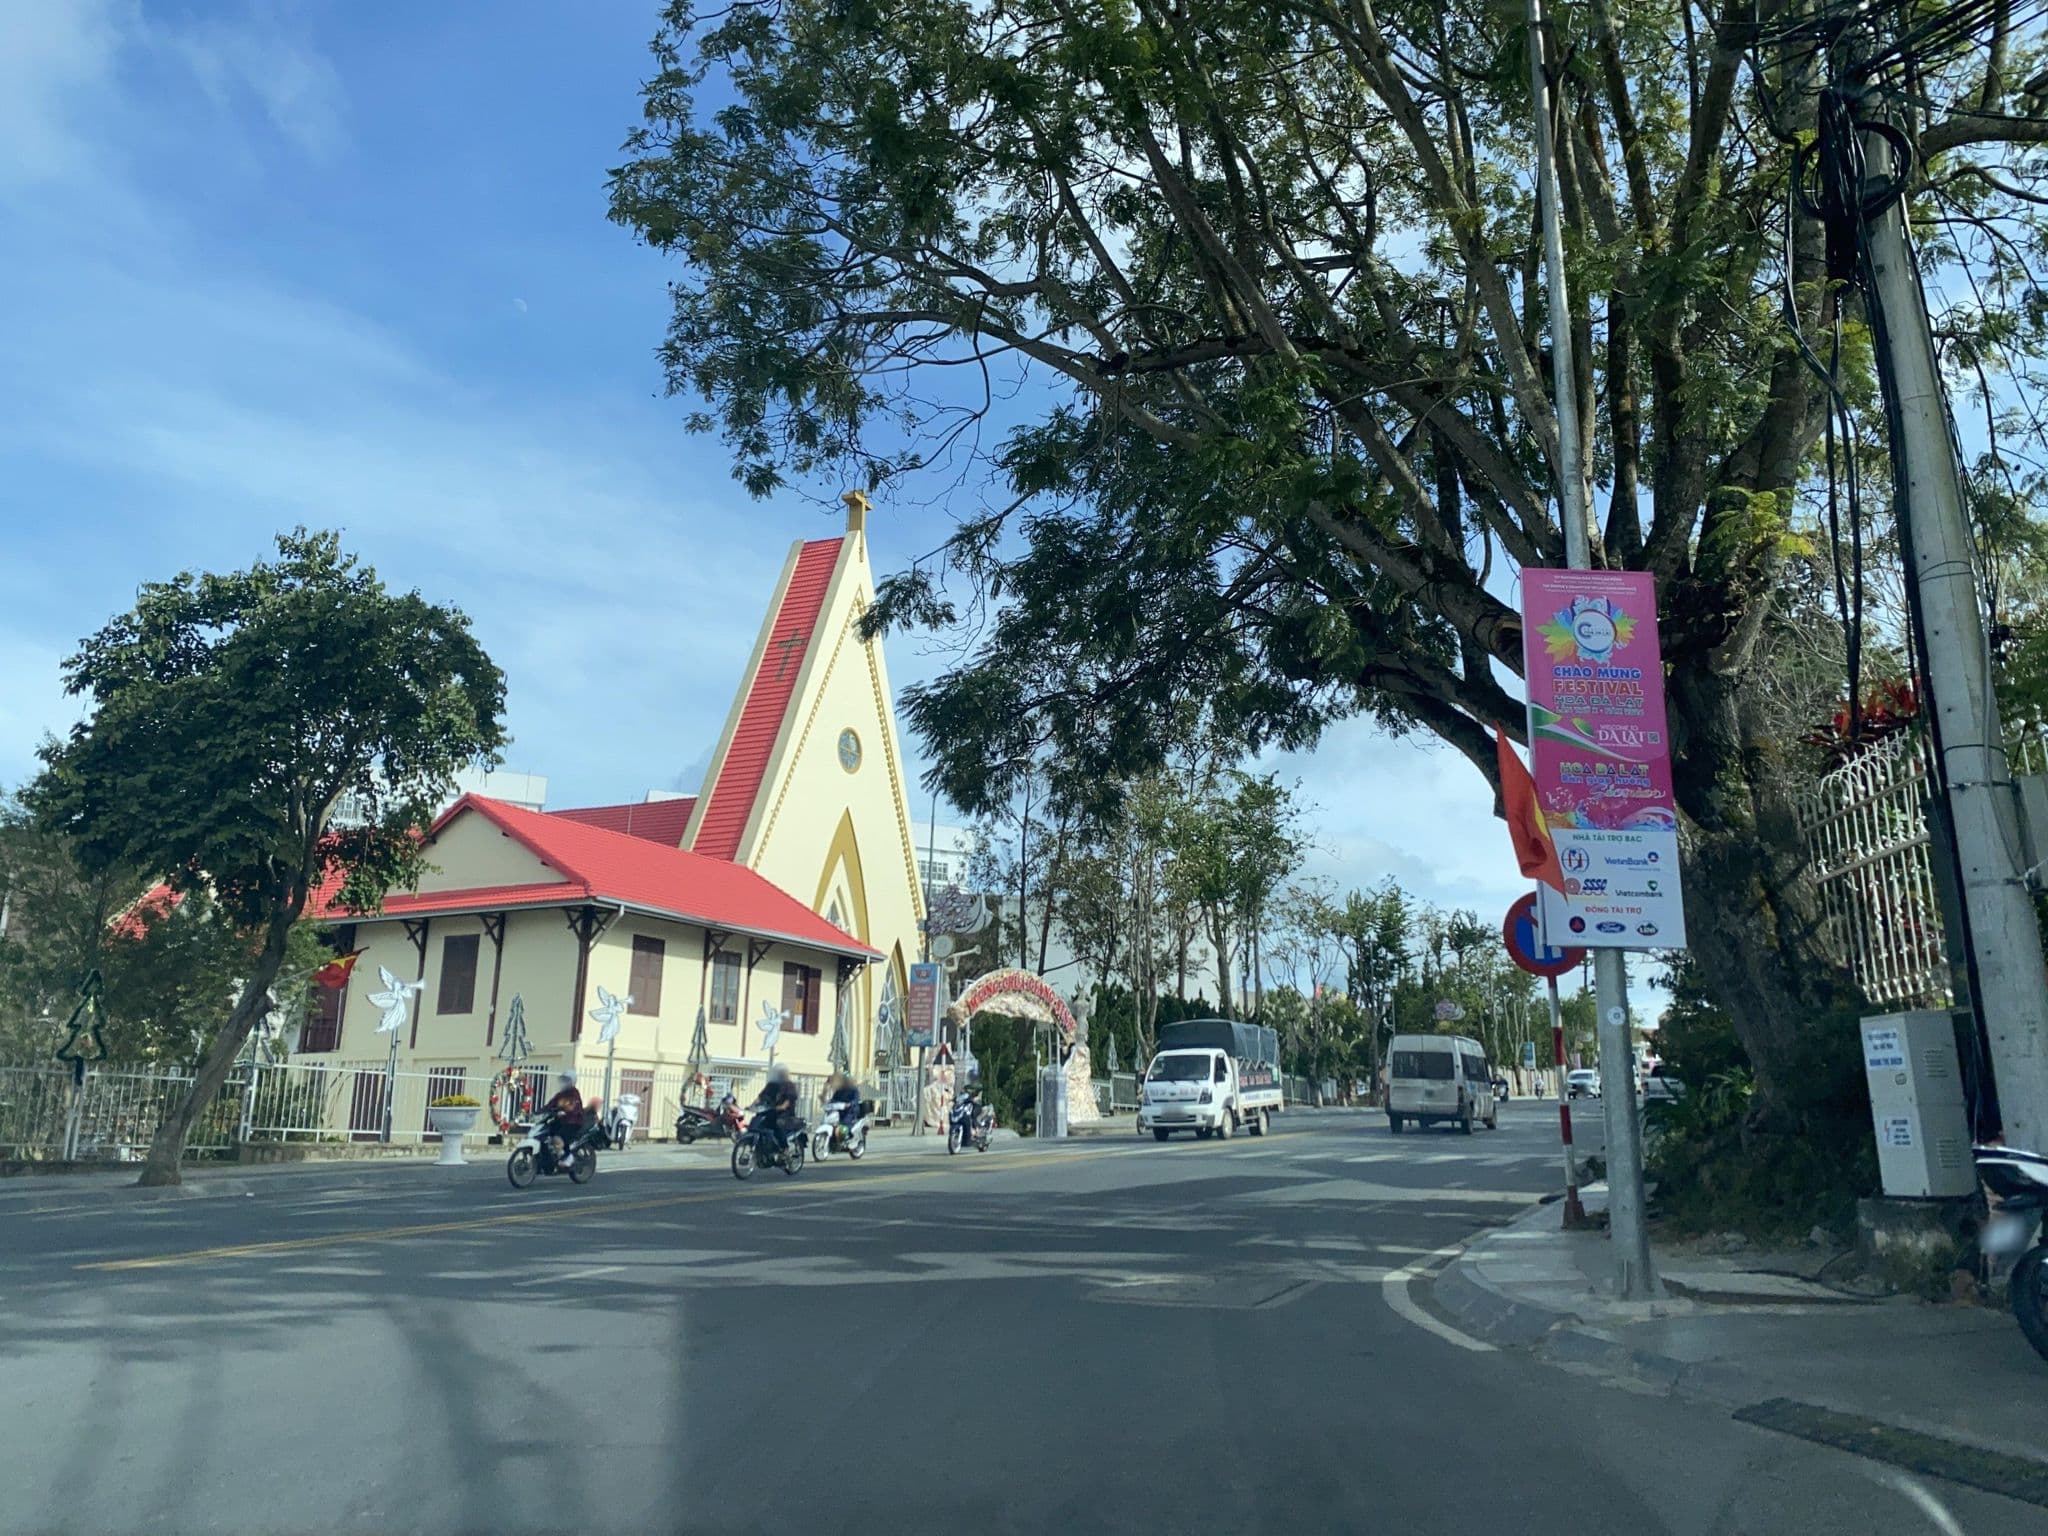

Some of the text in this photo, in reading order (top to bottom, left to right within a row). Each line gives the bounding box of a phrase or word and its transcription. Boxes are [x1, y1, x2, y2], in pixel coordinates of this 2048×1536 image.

[1553, 664, 1593, 678] CHÀO
[1553, 679, 1644, 695] FESTIVAL
[1559, 762, 1593, 775] HOA
[1604, 856, 1648, 866] VietinBank
[1615, 889, 1663, 898] Vietcombank
